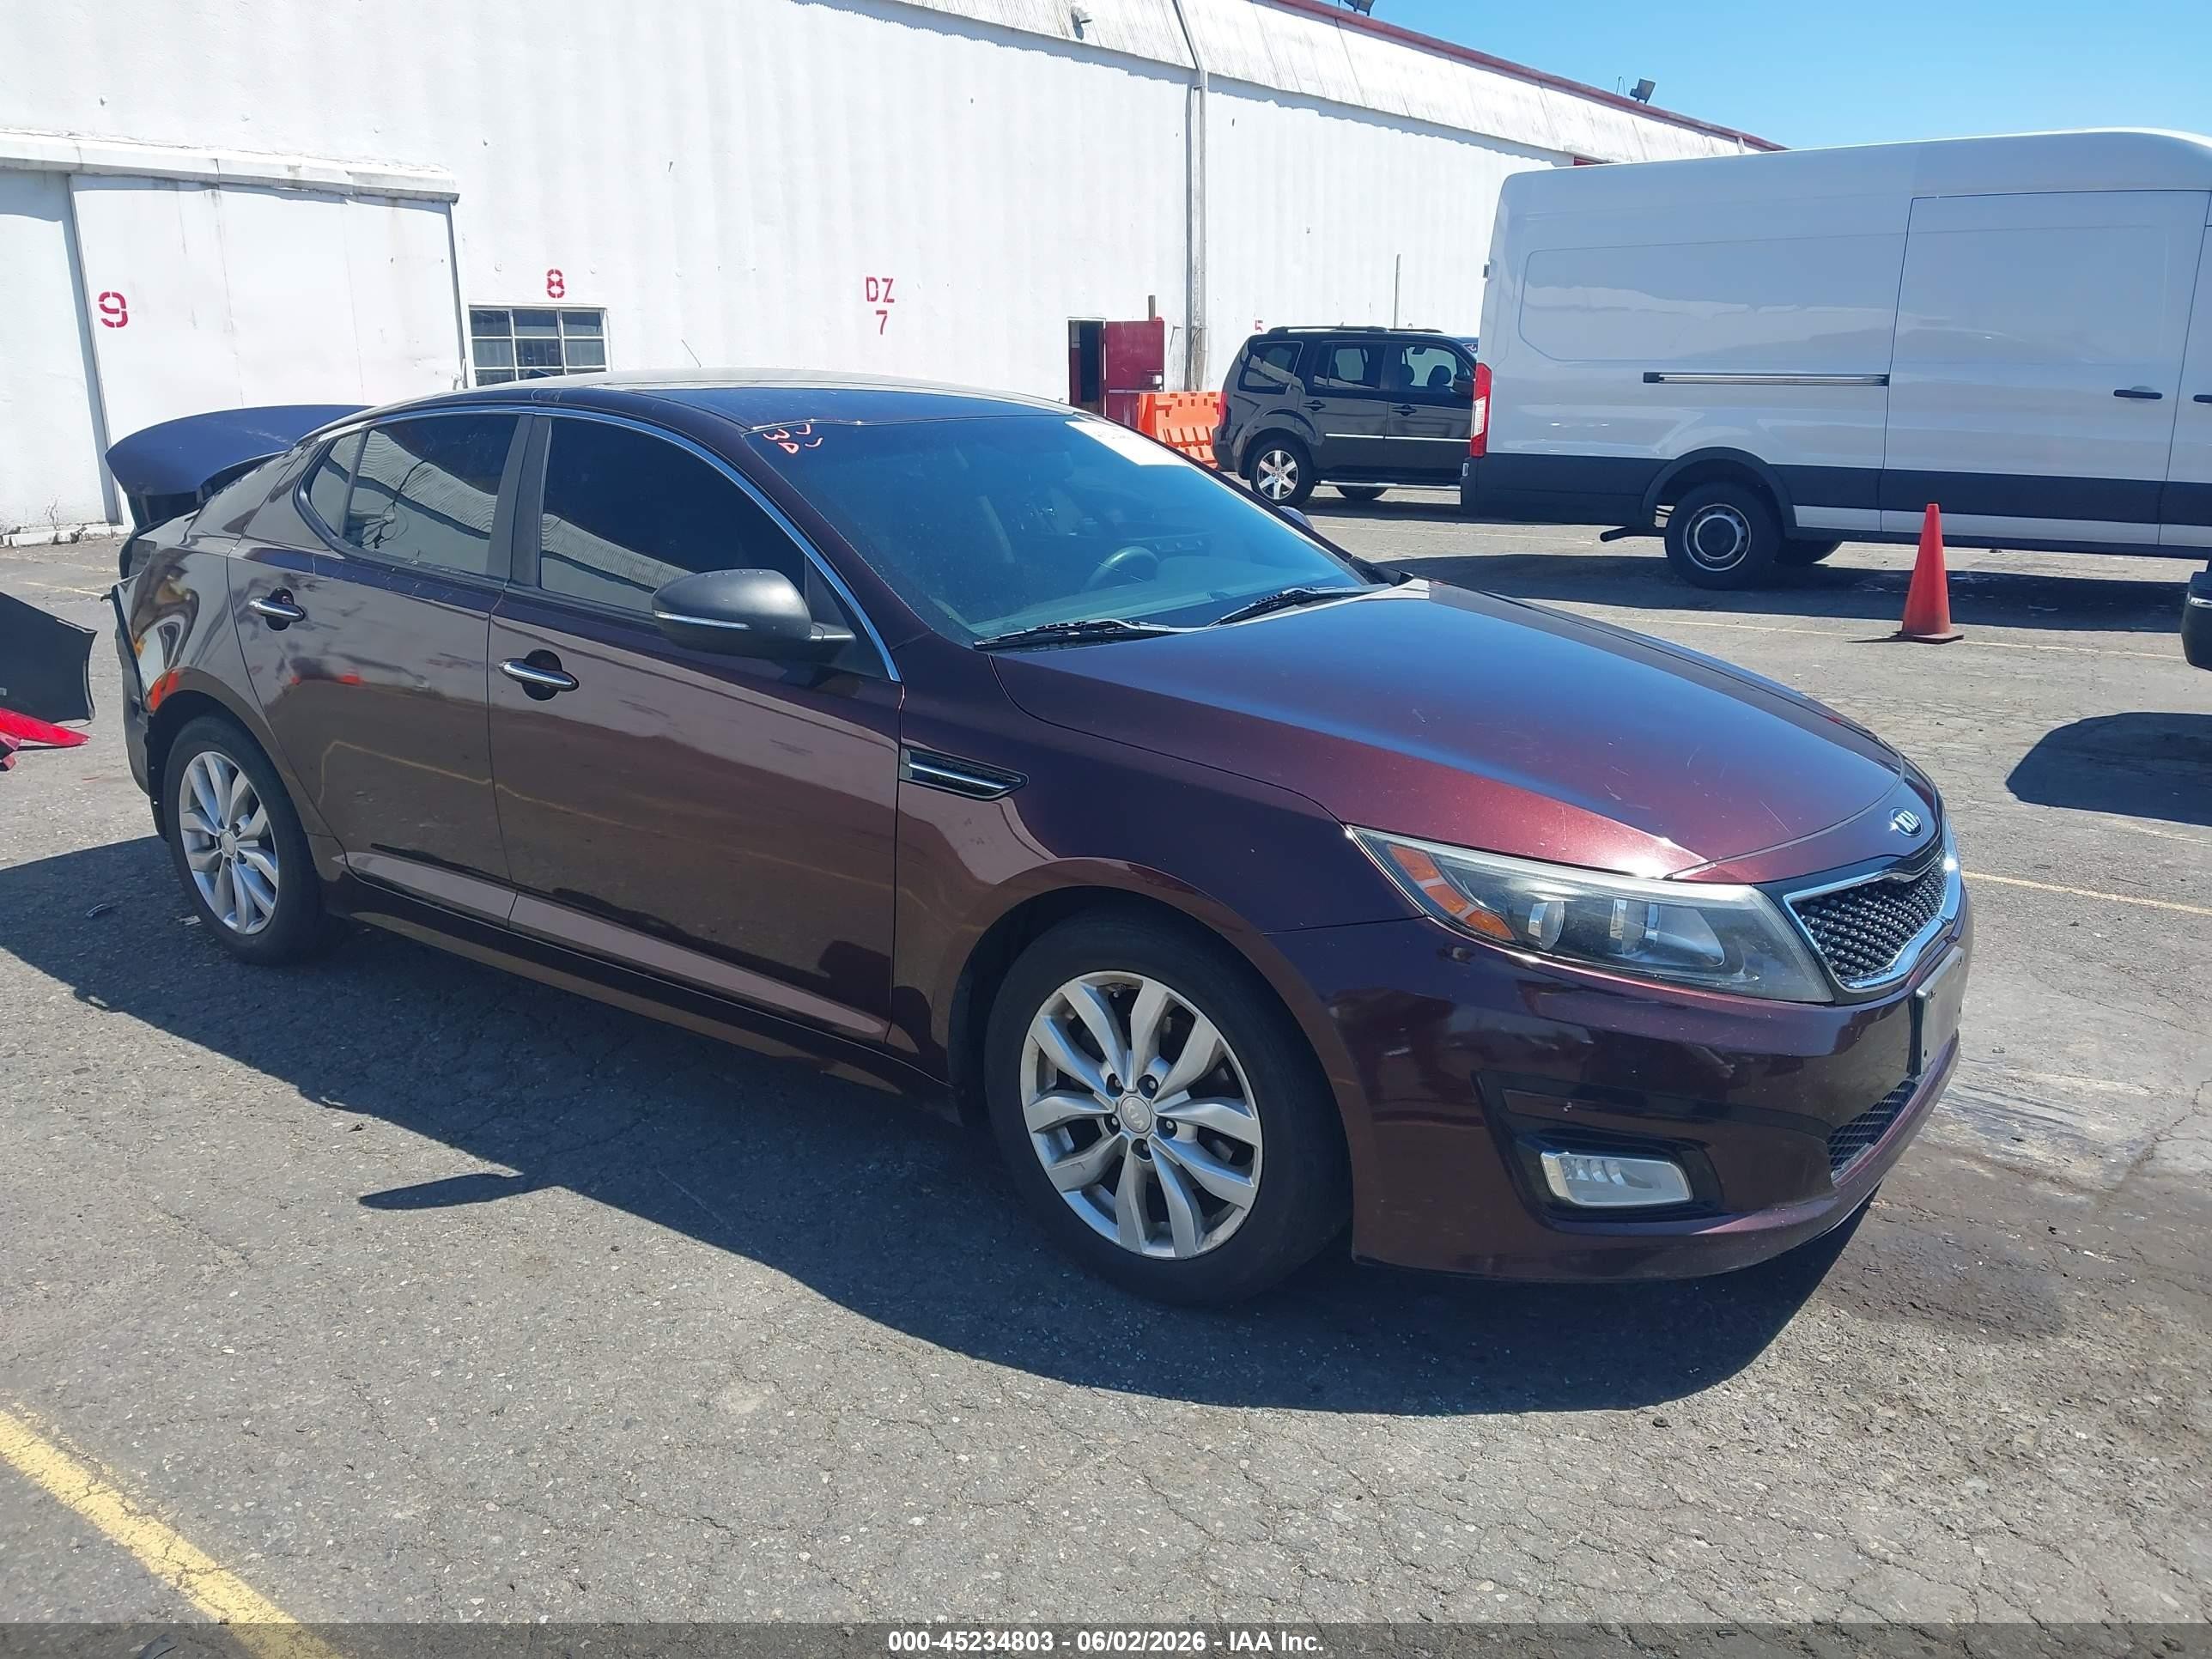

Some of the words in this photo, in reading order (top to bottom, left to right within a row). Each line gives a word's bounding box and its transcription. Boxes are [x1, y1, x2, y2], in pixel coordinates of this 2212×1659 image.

[547, 269, 565, 298] 8
[866, 276, 895, 303] DZ
[99, 291, 128, 328] 9
[876, 310, 887, 335] 7
